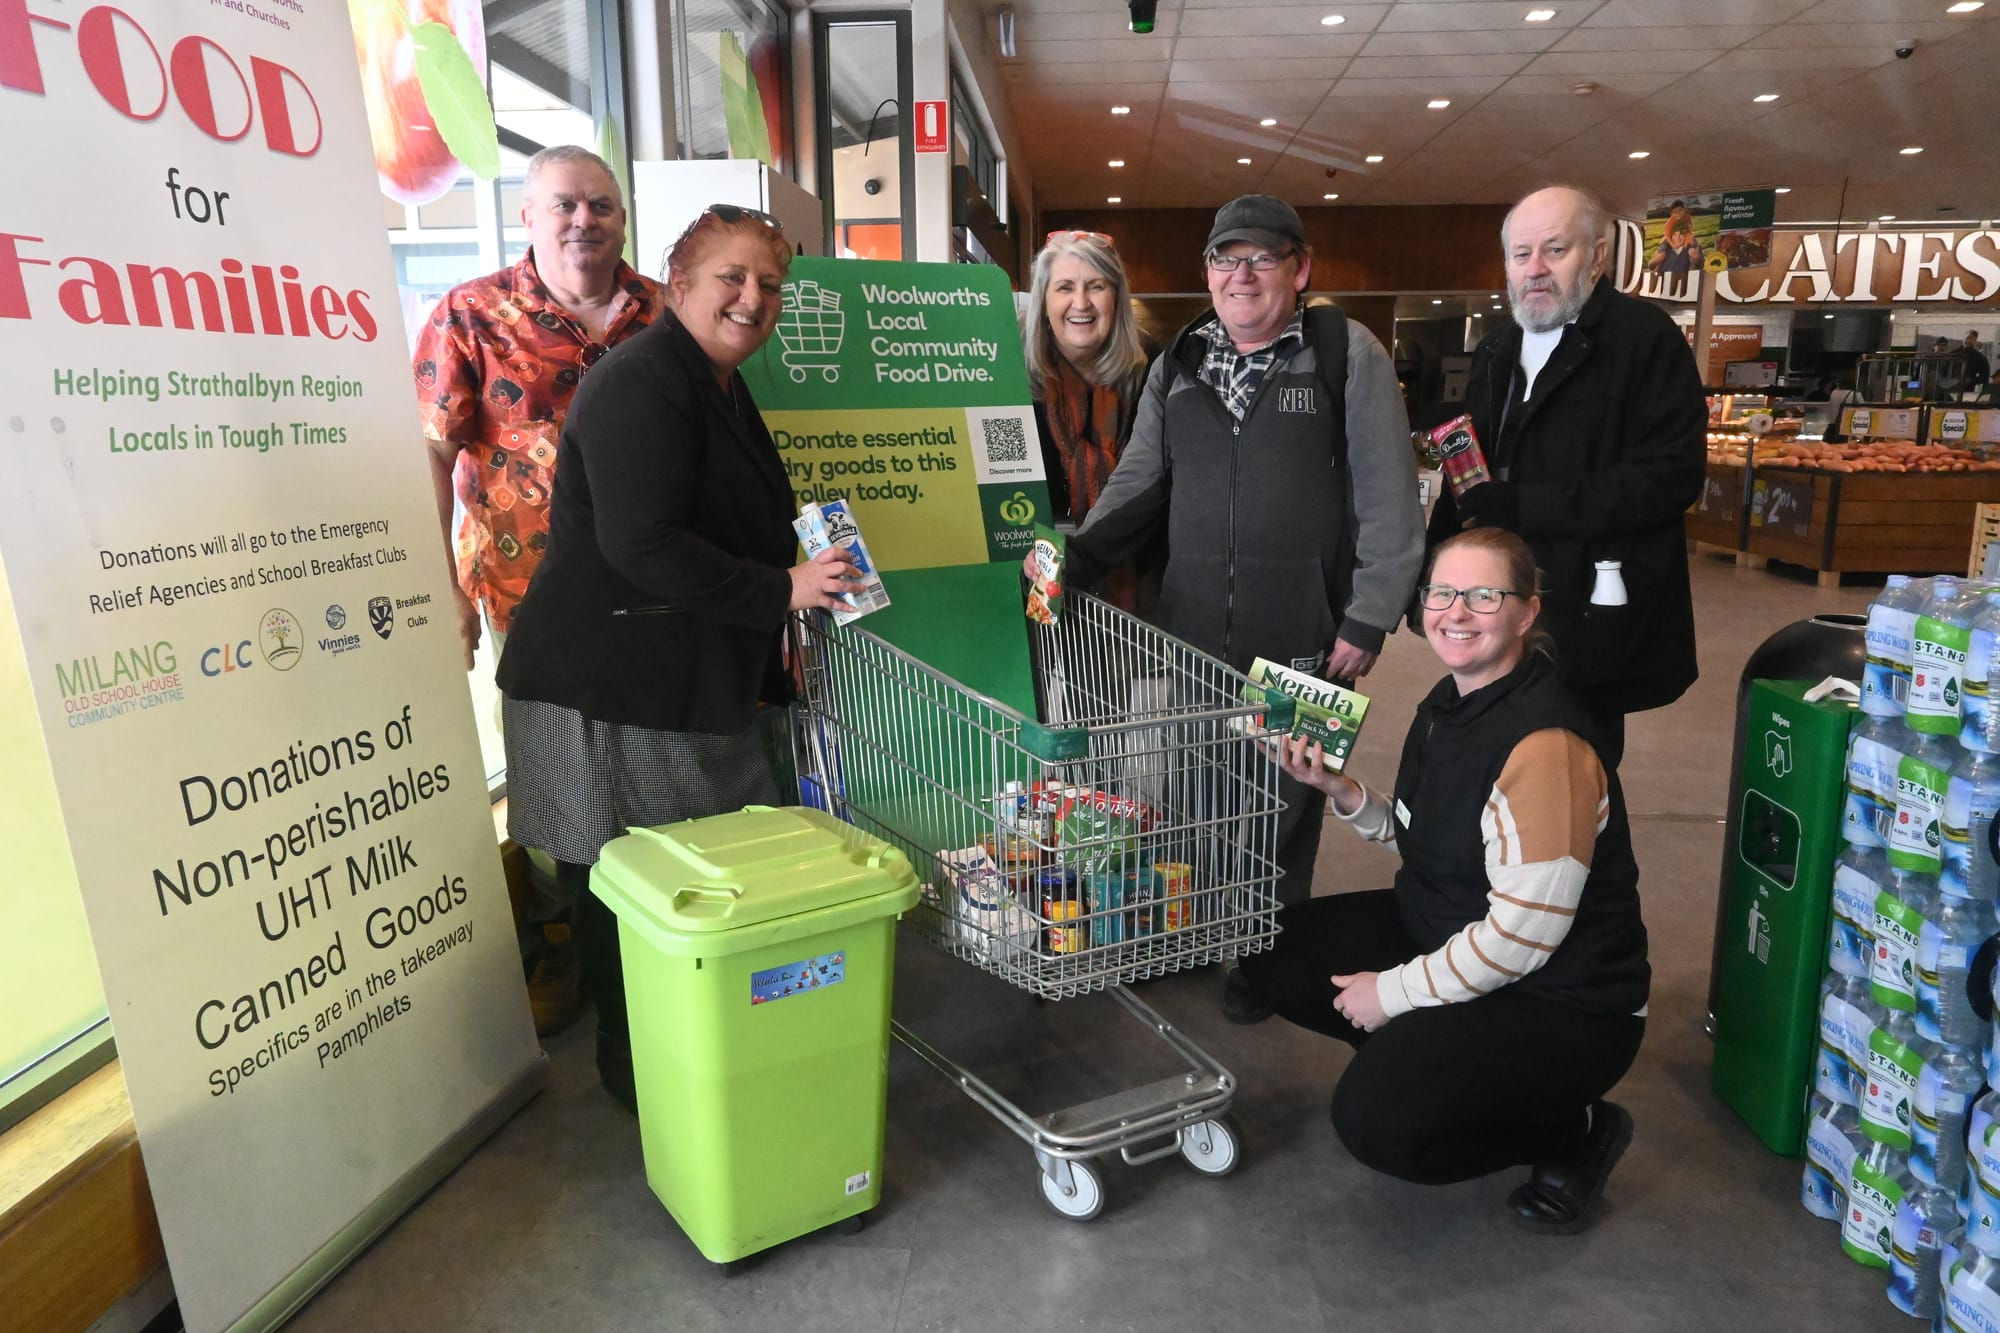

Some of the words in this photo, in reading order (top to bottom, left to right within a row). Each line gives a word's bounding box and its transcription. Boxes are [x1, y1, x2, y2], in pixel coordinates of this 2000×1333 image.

[246, 4, 291, 30] Churches
[0, 0, 322, 157] FOOD
[166, 167, 230, 226] for
[1724, 204, 1754, 212] flavours
[1722, 212, 1731, 220] of
[1731, 211, 1755, 219] winter
[0, 233, 378, 343] Families
[861, 283, 991, 307] Woolworths
[866, 310, 928, 331] Local
[1718, 332, 1758, 341] Approved
[870, 337, 998, 362] Community
[53, 368, 161, 401] Helping
[168, 371, 295, 401] Strathalbyn
[301, 374, 363, 401] Region
[874, 363, 931, 383] Food
[934, 363, 994, 383] Drive.
[1279, 387, 1317, 414] NBL
[108, 422, 188, 453] Locals
[194, 425, 213, 449] in
[218, 422, 284, 453] Tough
[290, 422, 347, 446] Times
[1852, 421, 1869, 430] Special
[1943, 424, 1965, 433] Special
[773, 429, 858, 450] Donate
[862, 426, 957, 448] essential
[783, 459, 814, 482] dry
[820, 454, 886, 481] goods
[890, 454, 912, 472] to
[916, 452, 957, 471] this
[988, 467, 1013, 475] Discover
[795, 481, 852, 504] rolley
[855, 481, 924, 504] today.
[100, 540, 197, 571] Donations
[200, 535, 228, 558] will
[231, 532, 247, 554] all
[250, 534, 268, 552] go
[270, 528, 287, 547] to
[291, 525, 318, 545] the
[321, 517, 390, 545] Emergency
[829, 526, 857, 542] DEVONDALE
[994, 528, 1034, 542] Woolwor
[1010, 541, 1022, 550] fresh
[1036, 543, 1054, 559] HEINZ
[89, 585, 144, 615] Relief
[150, 574, 227, 606] Agencies
[230, 568, 255, 591] and
[258, 559, 308, 587] School
[311, 553, 374, 580] Breakfast
[376, 547, 407, 572] Clubs
[396, 594, 431, 610] Breakfast
[407, 615, 428, 628] Clubs
[318, 634, 361, 651] Vinnies
[55, 641, 178, 699] MILANG
[200, 640, 253, 678] CLC
[64, 696, 89, 714] OLD
[92, 688, 141, 708] SCHOOL
[141, 674, 183, 695] HOUSE
[1260, 665, 1354, 717] Nerada
[1945, 688, 1959, 699] 20c
[68, 700, 136, 728] COMMUNITY
[139, 687, 184, 711] CENTRE
[1300, 721, 1317, 735] Black
[1318, 728, 1329, 738] Tea
[1772, 711, 1790, 729] Wipes
[179, 729, 376, 826] Donations
[384, 704, 413, 750] of
[152, 763, 450, 916] Non-perishables
[255, 866, 333, 942] UHT
[346, 834, 419, 896] Milk
[1759, 883, 1769, 899] Bin
[195, 931, 348, 1050] Canned
[365, 873, 469, 950] Goods
[753, 974, 779, 989] Wheelie
[781, 971, 795, 983] Bin
[208, 1022, 310, 1097] Specifics
[315, 1002, 343, 1034] are
[345, 988, 362, 1011] in
[365, 965, 397, 999] the
[400, 919, 475, 974] takeaway
[316, 990, 413, 1069] Pamphlets
[1983, 1153, 2000, 1175] SPR
